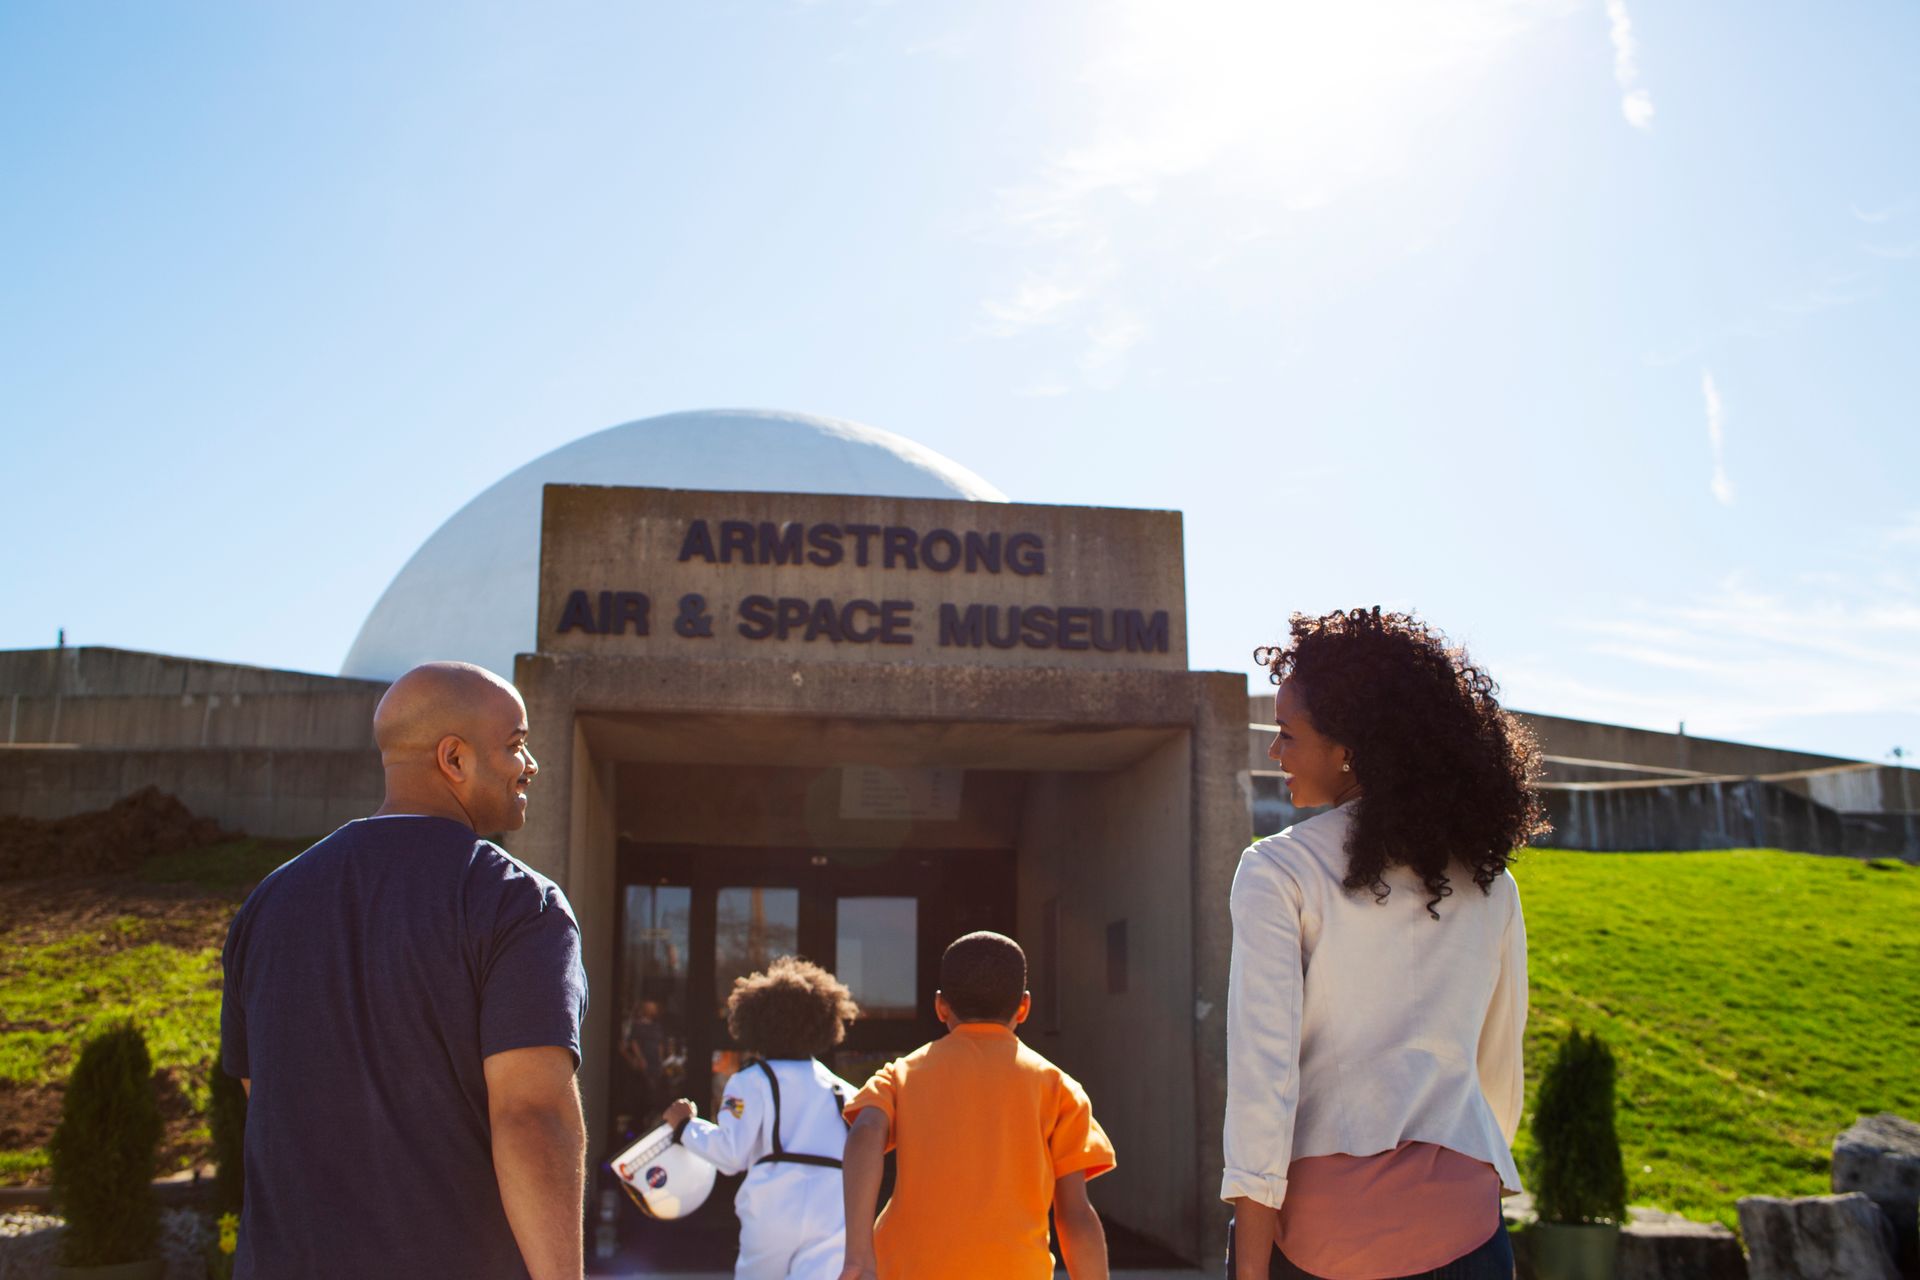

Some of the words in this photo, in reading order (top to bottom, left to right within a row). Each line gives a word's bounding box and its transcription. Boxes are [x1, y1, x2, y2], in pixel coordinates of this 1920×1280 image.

[678, 519, 1045, 576] ARMSTRONG
[556, 590, 650, 636] AIR
[674, 593, 713, 638] &
[738, 594, 914, 644] SPACE
[939, 602, 1169, 653] MUSEUM
